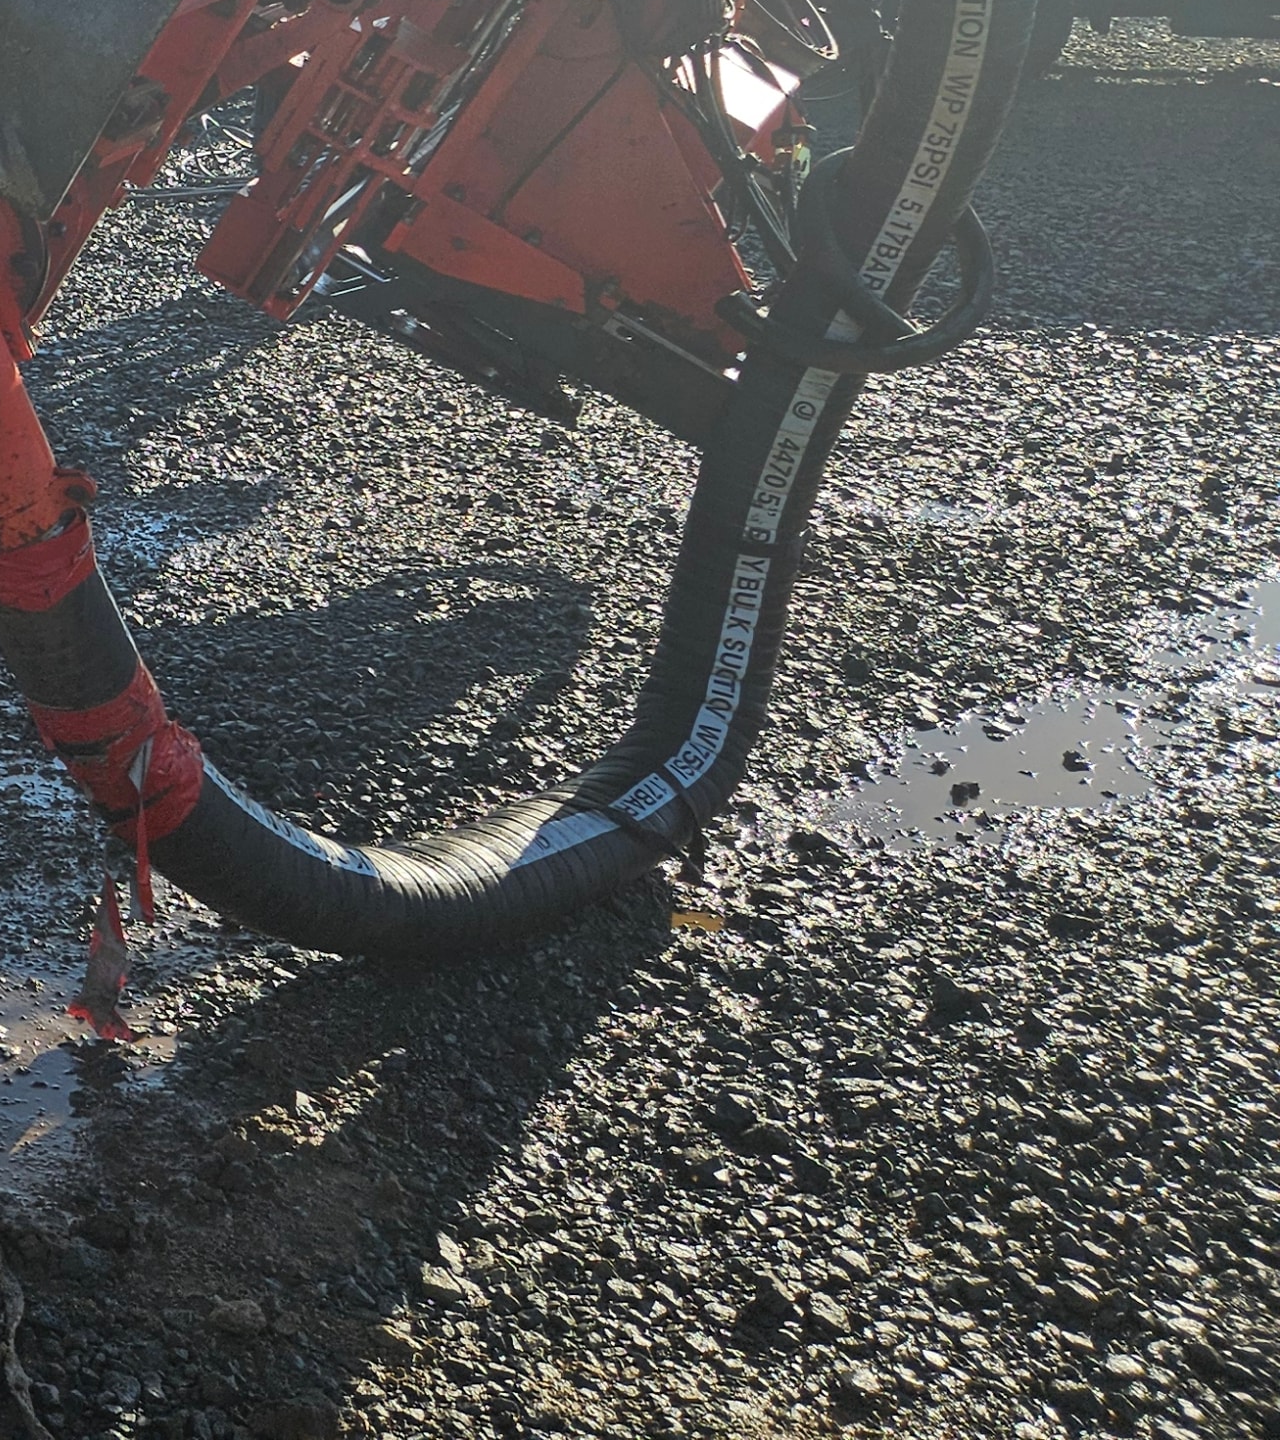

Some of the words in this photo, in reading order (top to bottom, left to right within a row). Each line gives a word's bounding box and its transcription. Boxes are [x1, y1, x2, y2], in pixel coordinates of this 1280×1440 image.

[942, 74, 974, 115] WP
[910, 122, 958, 190] 75PSI
[763, 437, 800, 489] 4470
